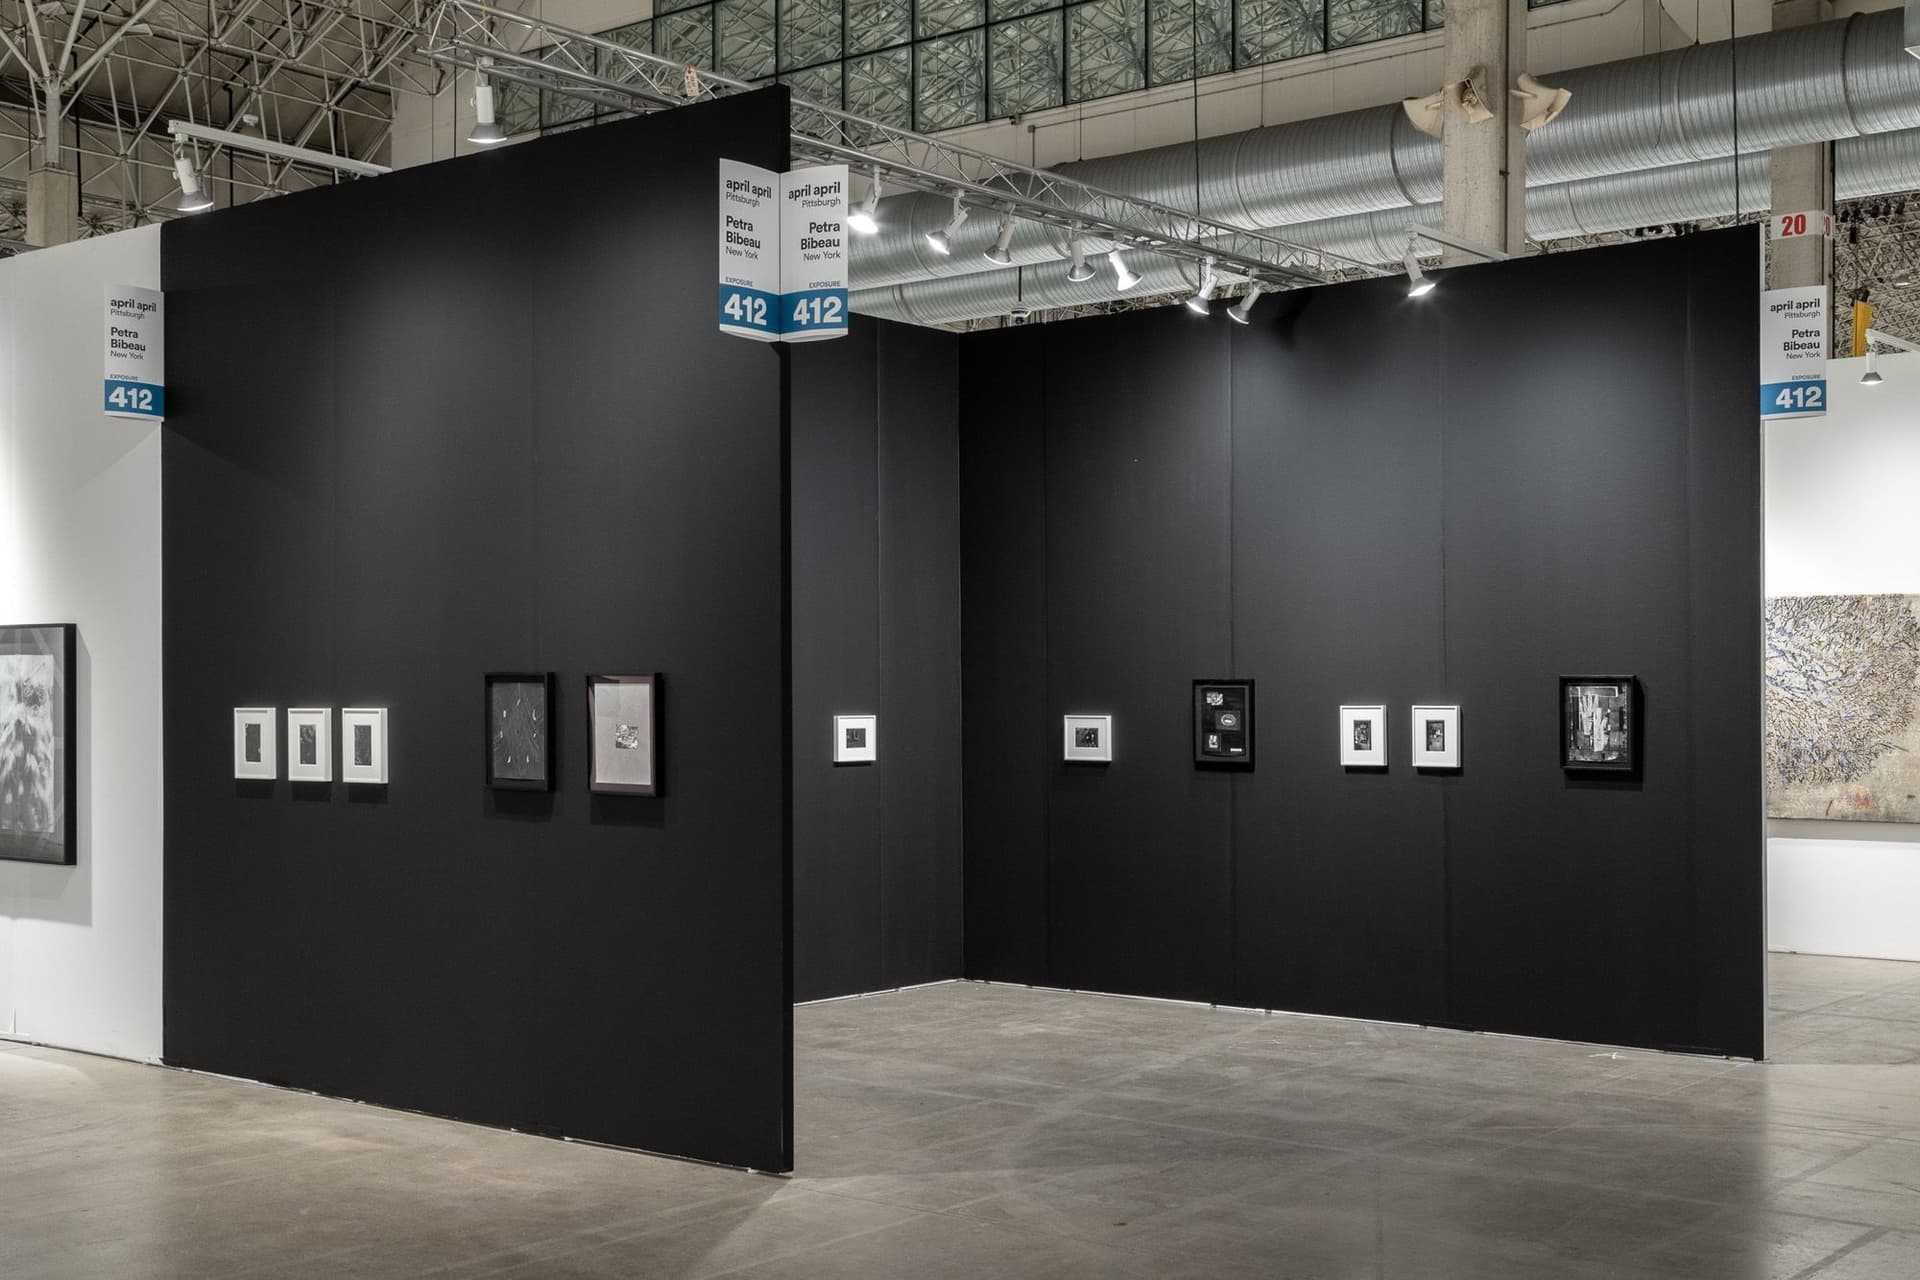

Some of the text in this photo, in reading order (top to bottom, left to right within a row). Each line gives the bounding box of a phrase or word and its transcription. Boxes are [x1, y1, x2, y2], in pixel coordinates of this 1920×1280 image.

[726, 180, 772, 199] april april
[788, 181, 841, 200] april april
[725, 192, 760, 208] Pittsburgh
[801, 197, 841, 208] Pittsburgh
[726, 215, 754, 232] Petra
[809, 222, 841, 234] Petra
[1781, 214, 1807, 236] 20
[726, 231, 761, 249] Bibeau
[800, 237, 841, 250] Bibeau
[725, 246, 759, 260] New York
[803, 250, 841, 262] New York
[725, 276, 753, 287] EXPOSURE
[809, 280, 841, 289] EXPOSURE
[110, 299, 157, 312] april april
[724, 294, 767, 325] 412
[793, 296, 842, 325] 412
[1770, 298, 1821, 313] april april
[110, 308, 145, 320] Pittsburgh
[1784, 310, 1821, 320] Pittsburgh
[110, 326, 139, 339] Petra
[1791, 328, 1820, 339] Petra
[110, 338, 146, 352] Bibeau
[1783, 341, 1820, 351] Bibeau
[110, 350, 144, 360] New York
[1786, 350, 1821, 360] New York
[109, 387, 152, 410] 412
[1775, 387, 1822, 408] 412
